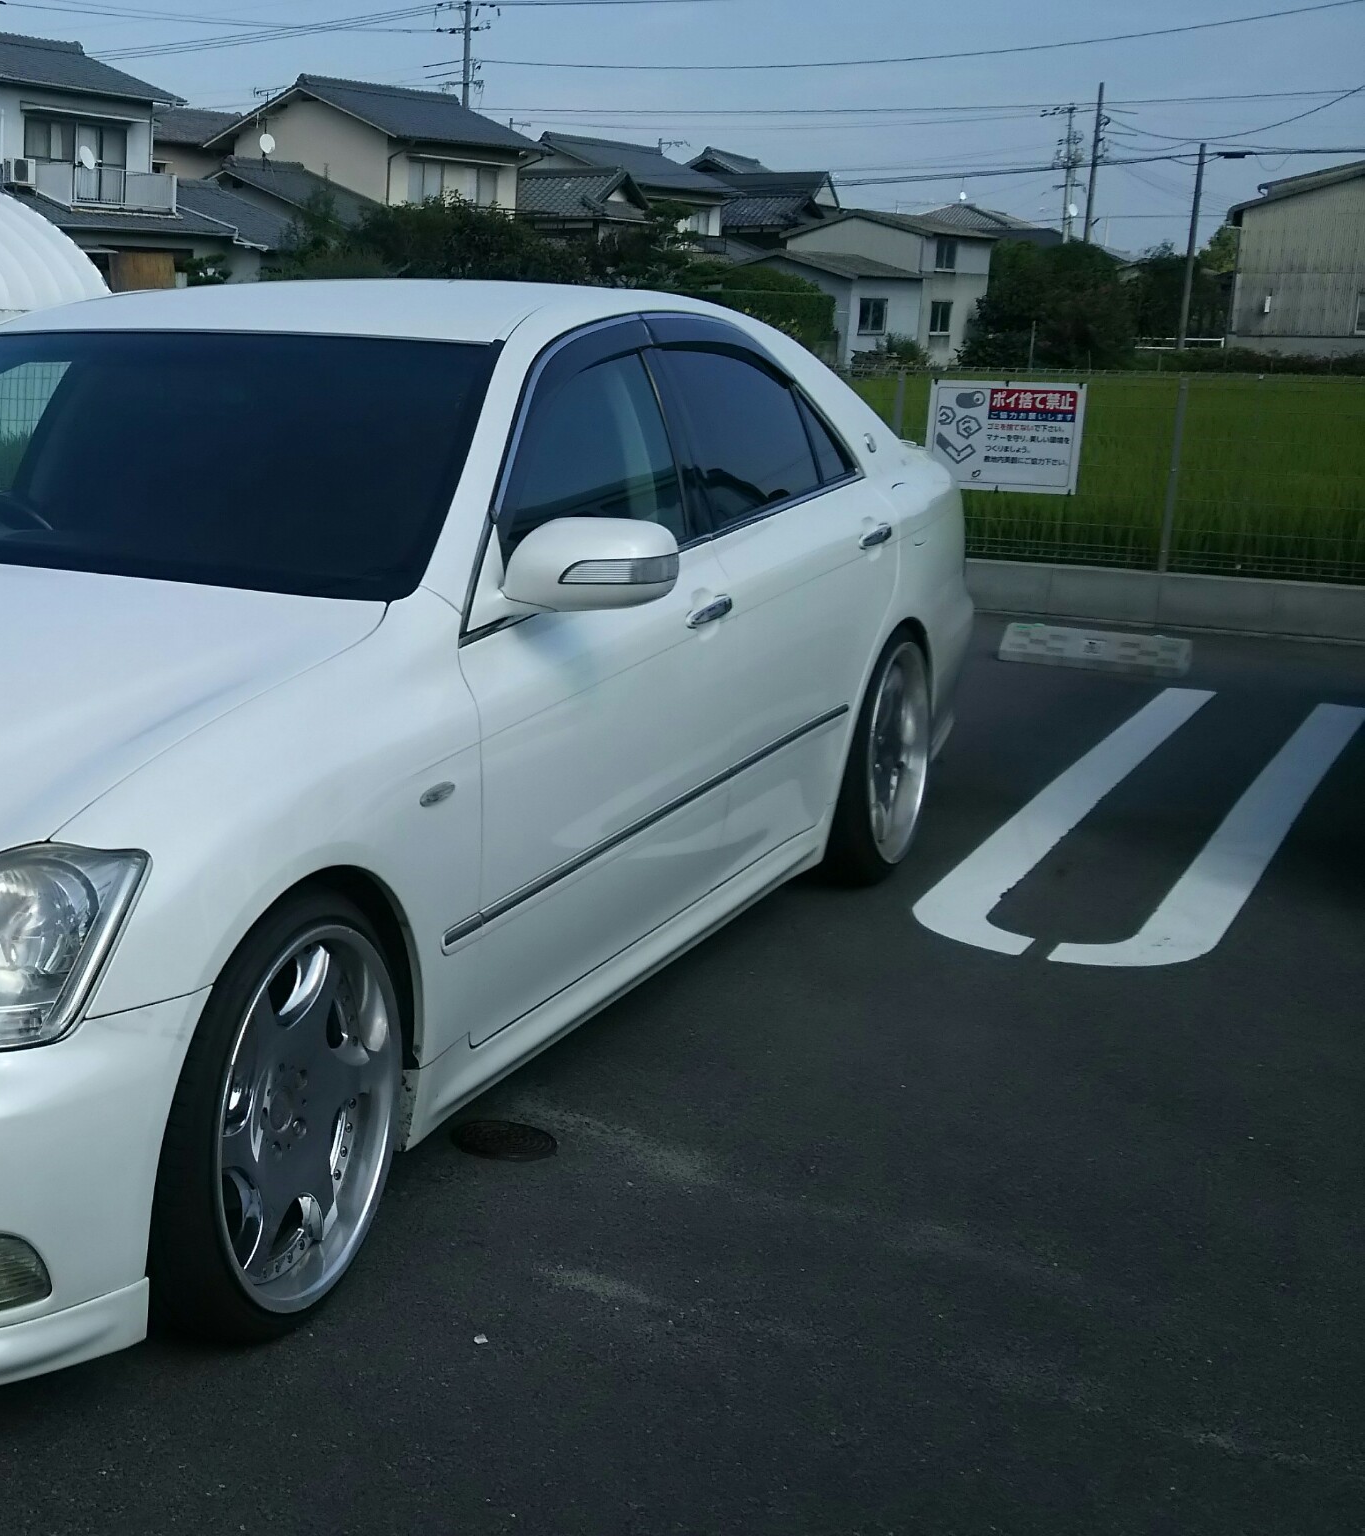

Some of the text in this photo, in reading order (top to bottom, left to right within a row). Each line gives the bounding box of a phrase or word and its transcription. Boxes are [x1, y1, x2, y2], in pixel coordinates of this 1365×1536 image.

[992, 391, 1074, 410] ポイ捨て禁止
[990, 411, 1073, 421] ご協力お願いします
